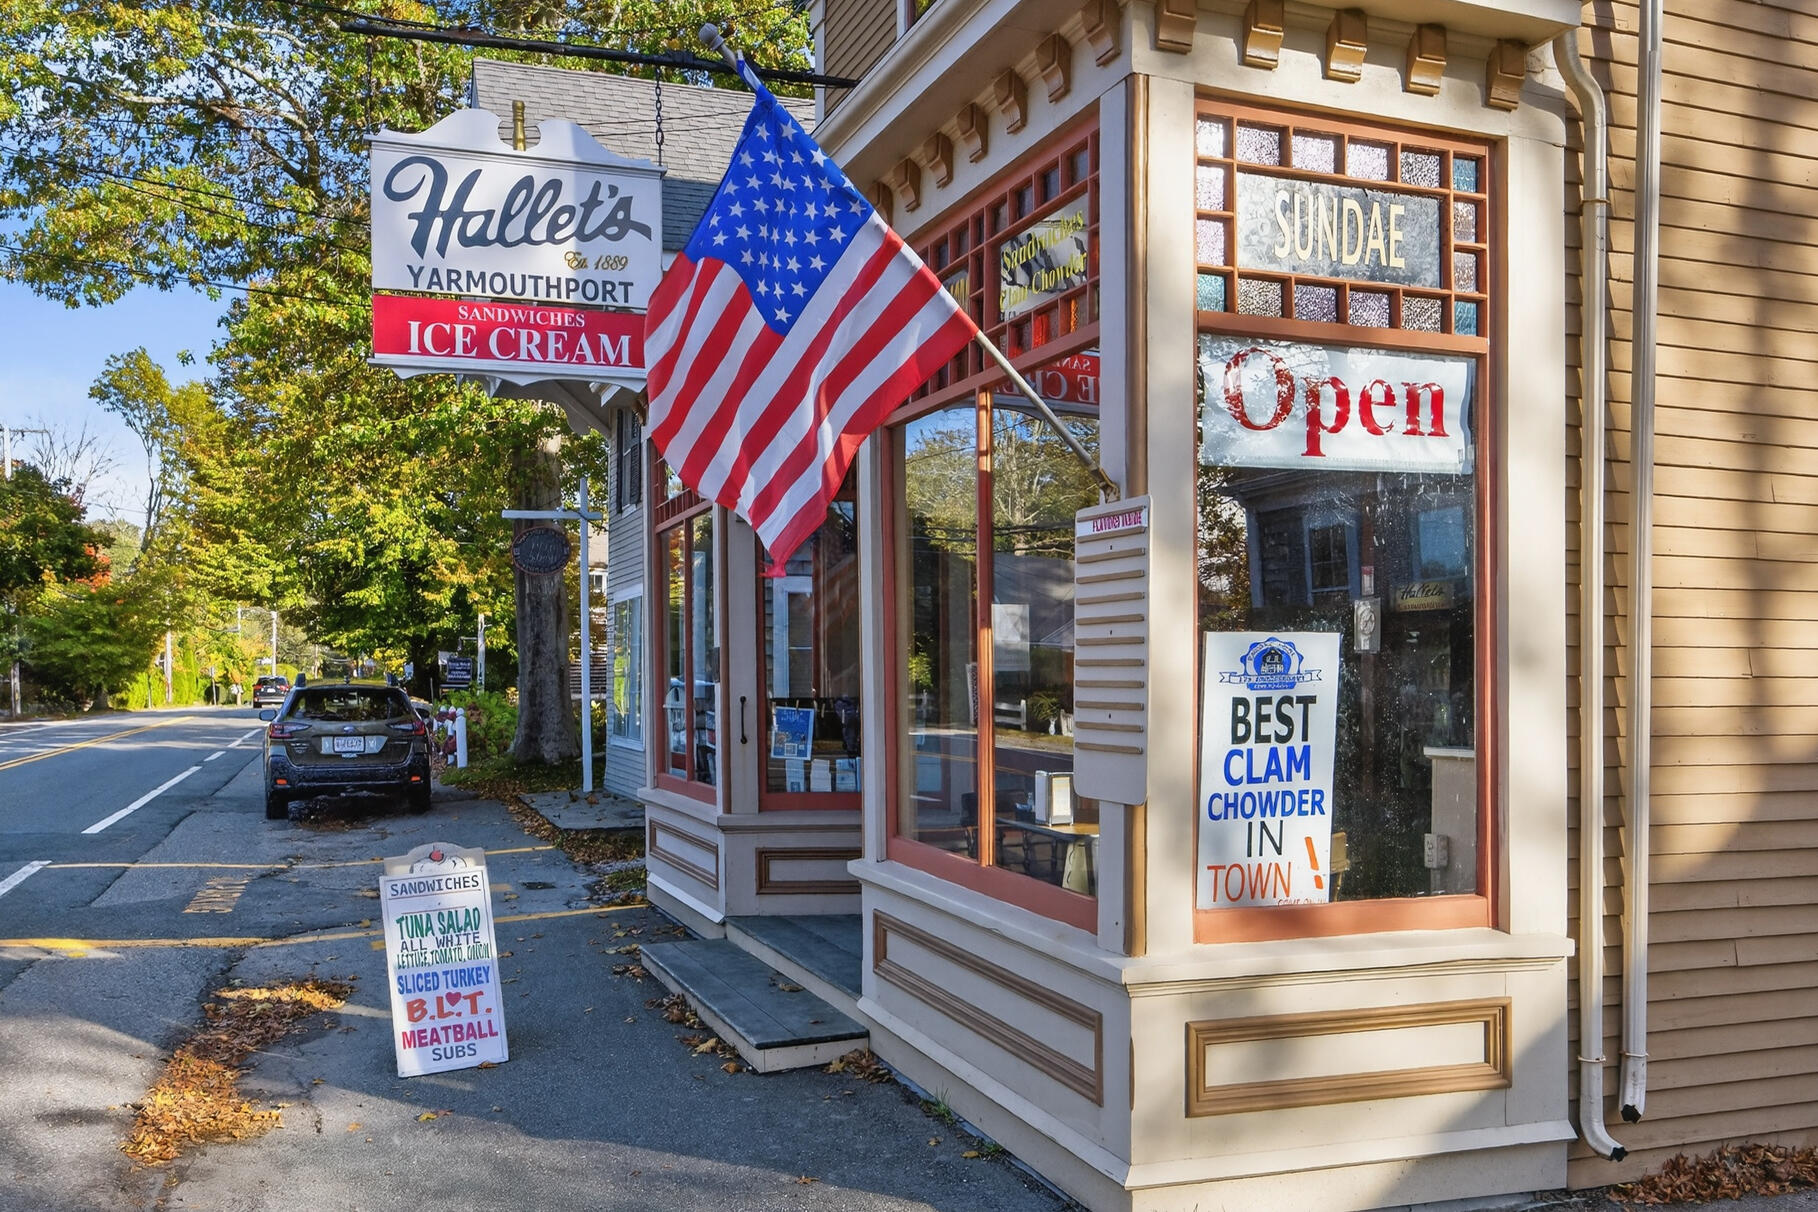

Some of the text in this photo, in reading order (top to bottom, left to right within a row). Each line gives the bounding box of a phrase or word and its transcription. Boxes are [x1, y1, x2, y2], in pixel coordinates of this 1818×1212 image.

[383, 156, 652, 260] Hallet's
[1273, 189, 1406, 269] SUNDAE
[594, 254, 629, 272] 1889
[1032, 251, 1088, 295] Chowder
[406, 263, 634, 304] YARMOUTHPORT
[458, 305, 586, 328] SANDWICHES
[407, 320, 632, 366] ICE CREAM
[1223, 347, 1451, 457] Open
[1230, 694, 1317, 745] BEST
[1223, 744, 1311, 787] CLAM
[1207, 788, 1326, 822] CHOWDER
[1246, 819, 1284, 858] IN
[389, 874, 480, 898] SANDWICHES
[1206, 861, 1292, 903] TOWN
[395, 906, 481, 940] TUNA SALAD
[400, 931, 481, 953] ALL WHITE
[397, 965, 491, 995] SLICED TURKEY
[401, 1019, 499, 1051] MEATBALL
[431, 1042, 477, 1062] SUBS
